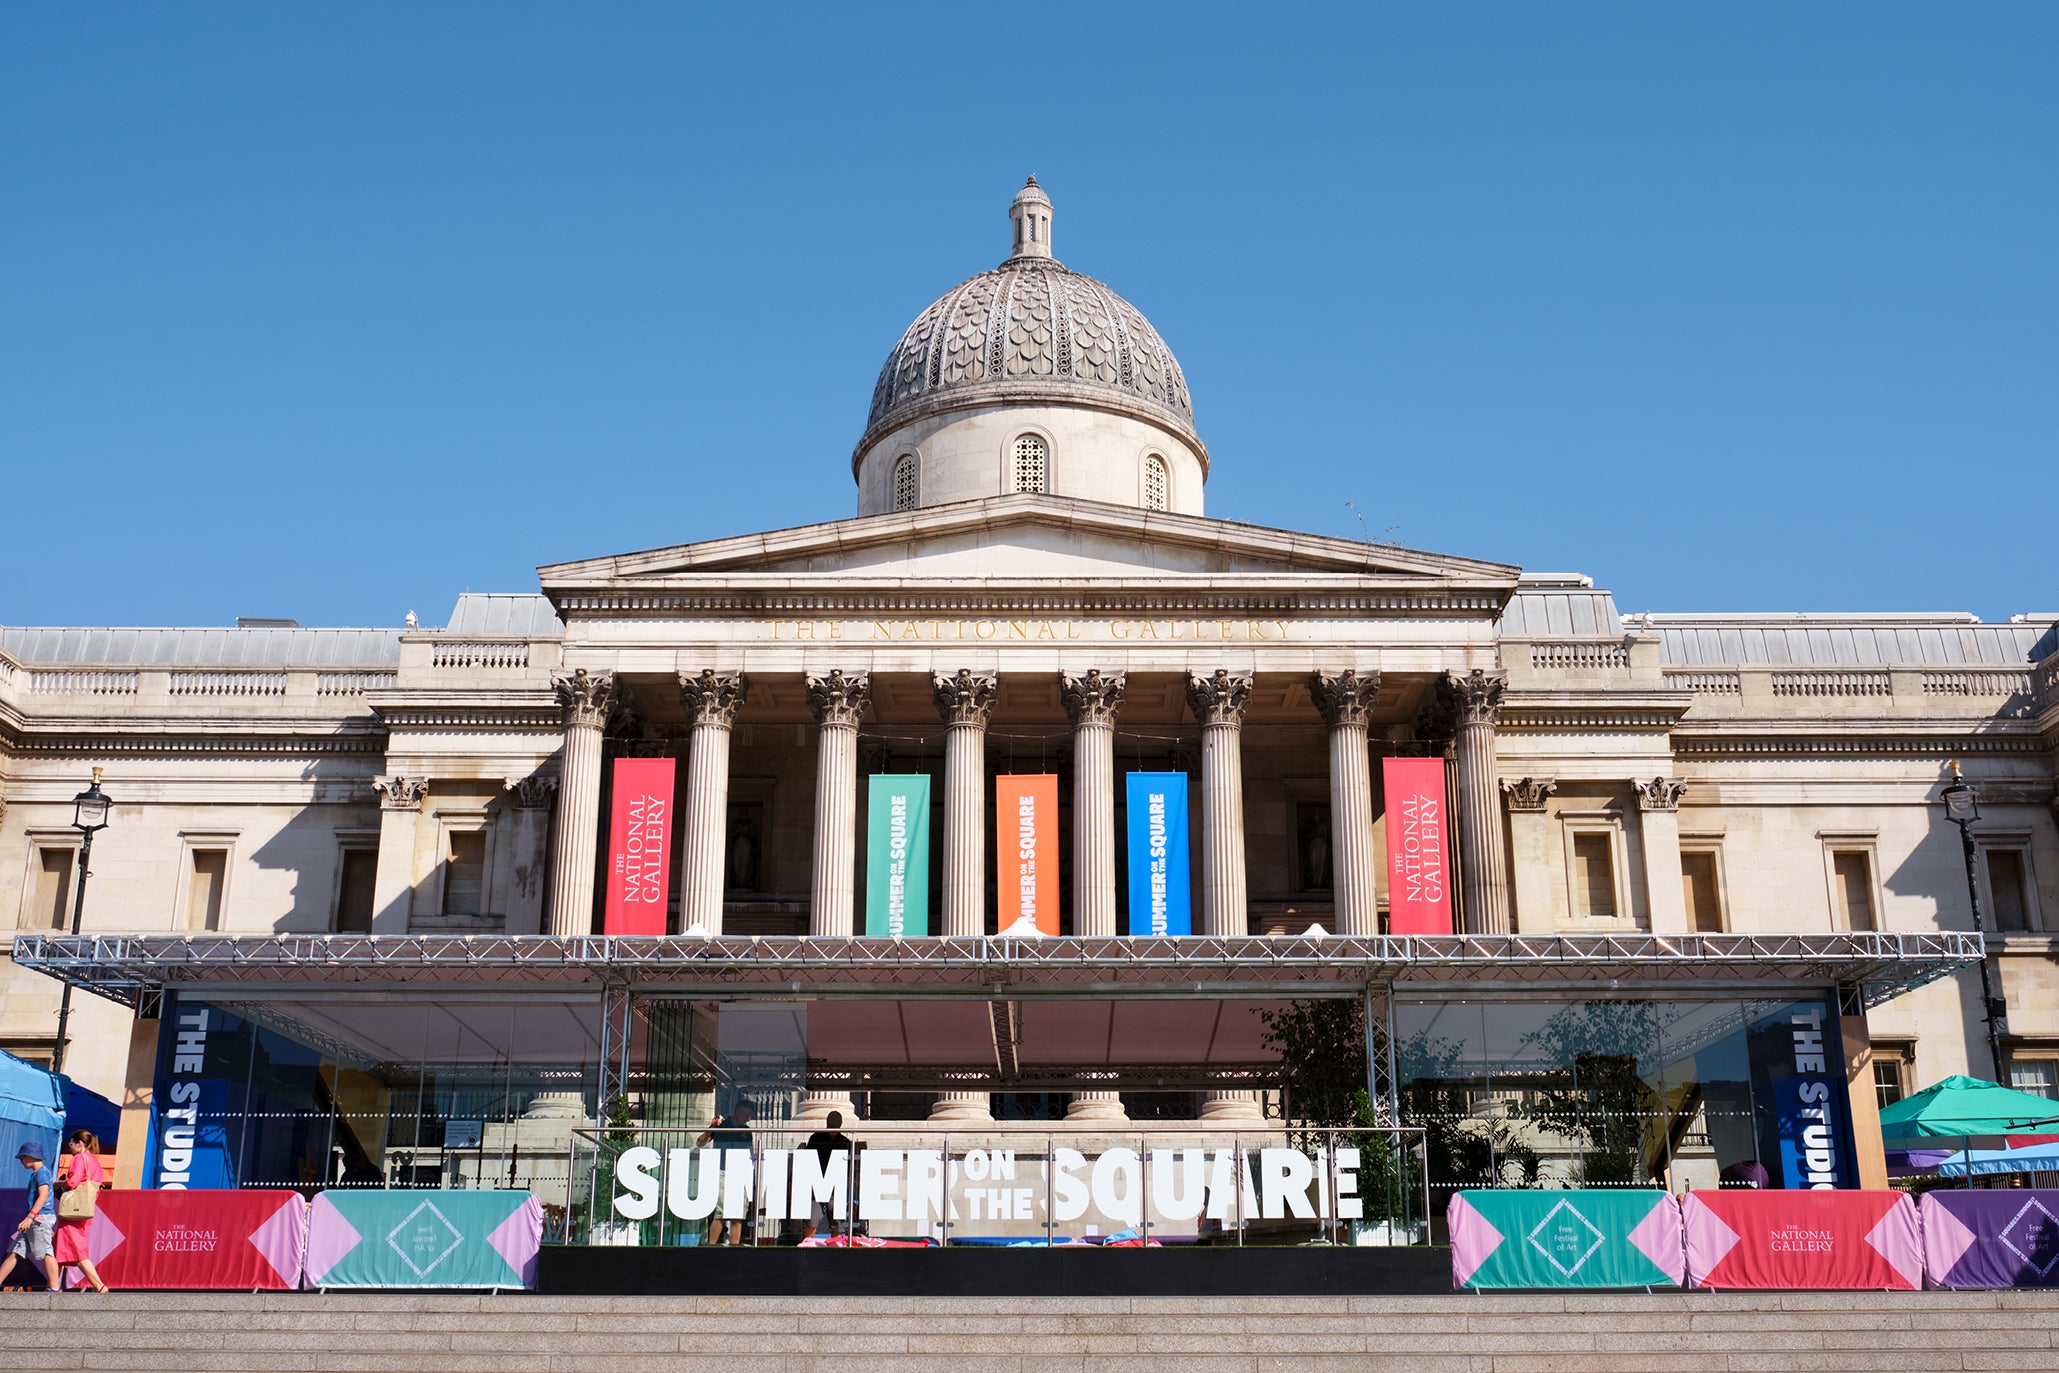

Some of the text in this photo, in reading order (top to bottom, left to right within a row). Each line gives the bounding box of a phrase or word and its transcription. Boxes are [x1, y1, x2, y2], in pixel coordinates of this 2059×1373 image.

[765, 619, 1291, 639] THE NATIONAL GALLERY
[890, 795, 907, 859] SQUARE
[1019, 796, 1036, 859] SQUARE
[1149, 793, 1167, 857] SQUARE
[624, 794, 645, 903] NATIONAL
[642, 795, 665, 903] GALLERY
[1403, 794, 1422, 902] NATIONAL
[1420, 794, 1443, 903] GALLERY
[616, 853, 625, 875] THE
[890, 863, 897, 874] ON
[897, 861, 905, 874] THE
[1020, 863, 1027, 874] ON
[1151, 861, 1158, 872] ON
[1395, 853, 1403, 875] THE
[1020, 875, 1036, 924] MMER
[160, 1009, 209, 1189] THE STUDI
[1792, 1008, 1838, 1189] THE STUDI
[613, 1147, 1364, 1227] SUMMER ON THE SQUARE
[154, 1240, 217, 1251] GALLERY
[155, 1230, 218, 1240] NATIONAL
[1554, 1234, 1578, 1242] Festival
[1771, 1230, 1834, 1240] NATIONAL
[1771, 1240, 1834, 1251] GALLERY
[1557, 1243, 1564, 1251] of
